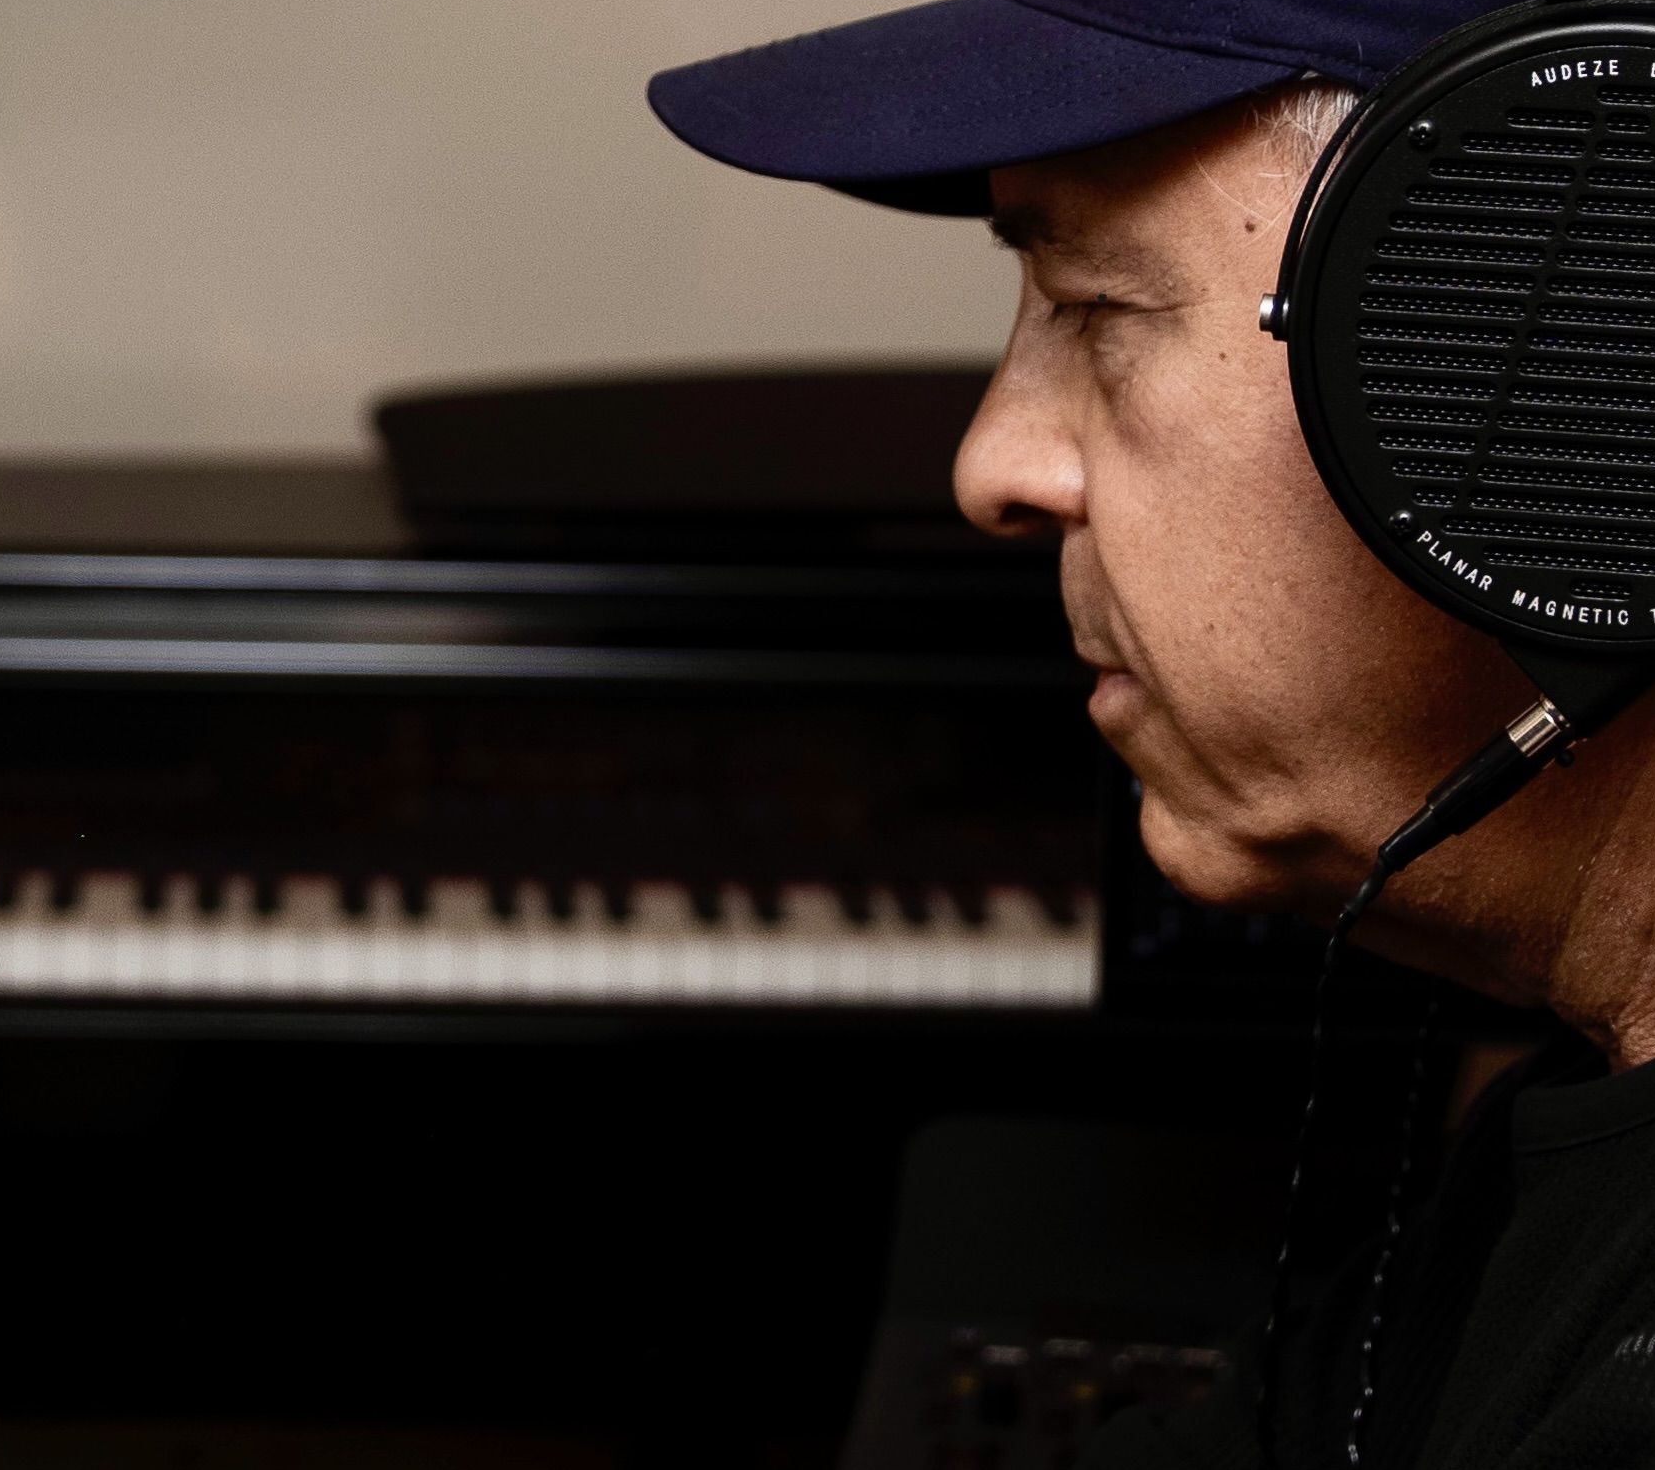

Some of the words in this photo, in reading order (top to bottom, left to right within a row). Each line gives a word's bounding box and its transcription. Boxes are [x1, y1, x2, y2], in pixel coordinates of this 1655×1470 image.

[1531, 60, 1620, 87] AUDEZE
[1417, 530, 1493, 591] PLANAR
[1511, 589, 1630, 626] MAGNETIC
